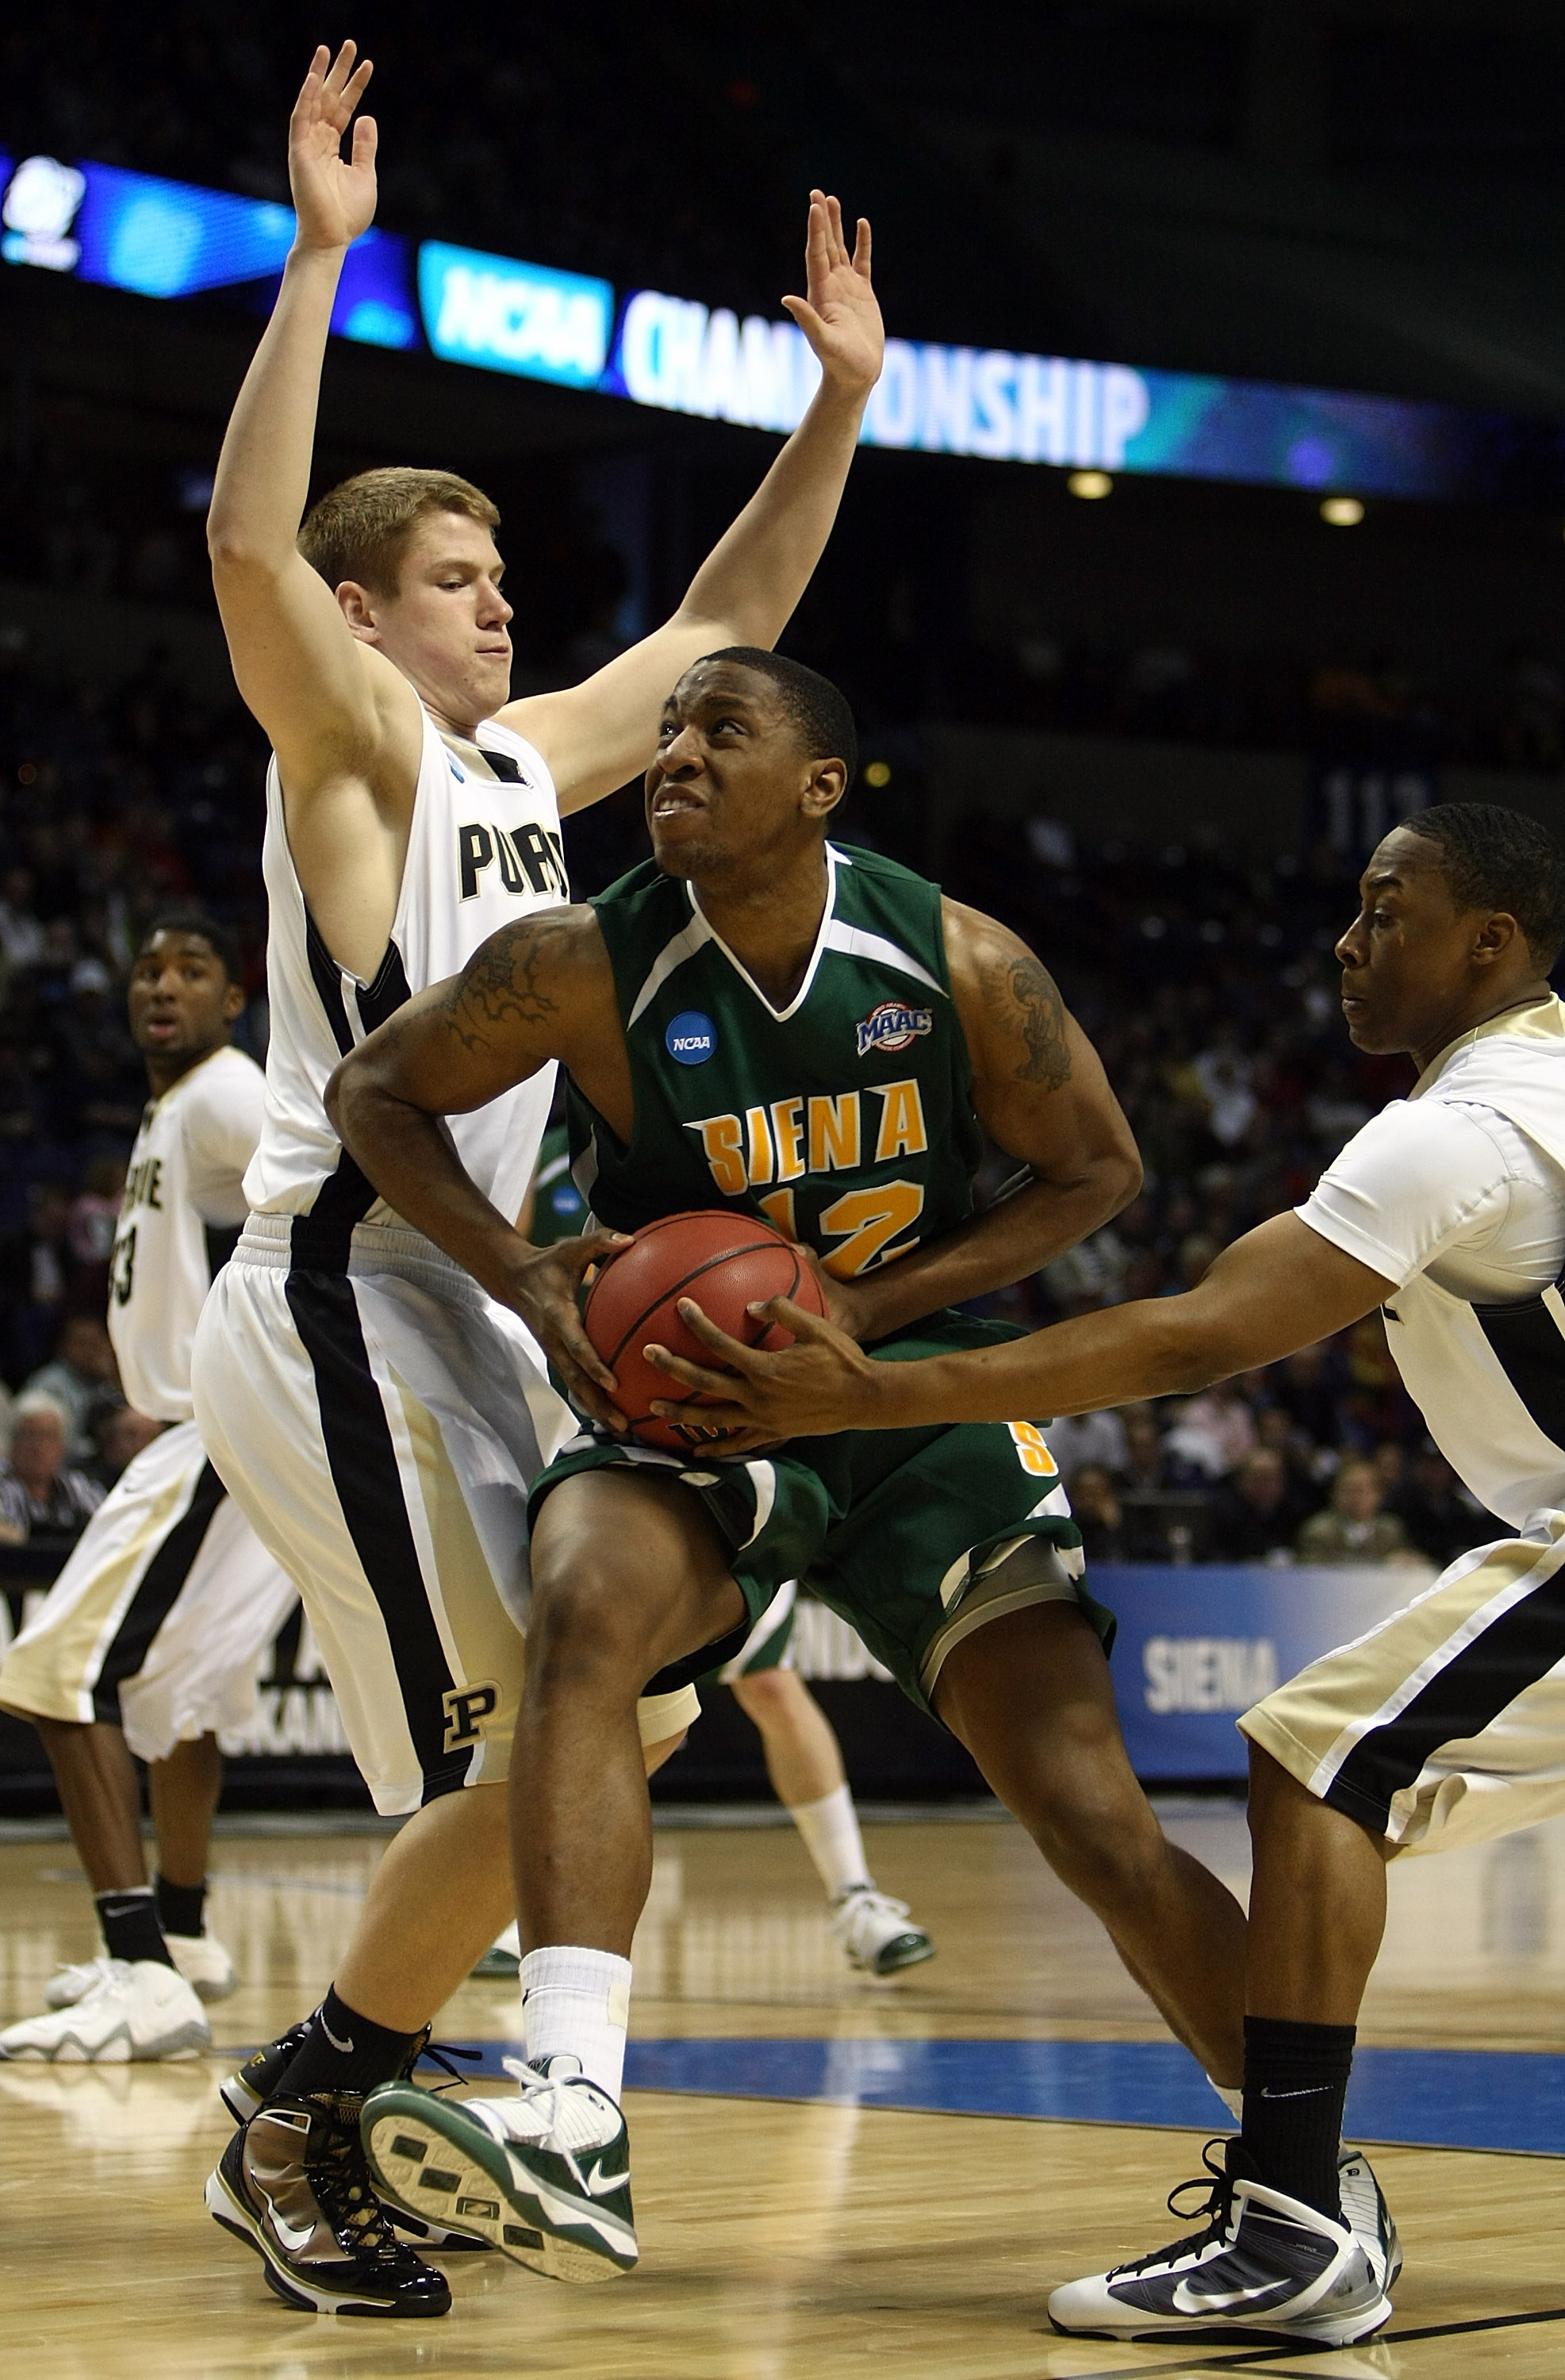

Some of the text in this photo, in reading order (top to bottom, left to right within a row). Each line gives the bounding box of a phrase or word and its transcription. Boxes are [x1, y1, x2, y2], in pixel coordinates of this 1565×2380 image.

[436, 267, 1149, 471] NCAA CHAMONSHIP
[673, 1036, 711, 1051] NCAA
[857, 1008, 932, 1057] MAAC
[682, 1079, 927, 1196] SIENA
[758, 1179, 925, 1283] 12
[1143, 1636, 1281, 1715] SIENA
[442, 1679, 503, 1754] P
